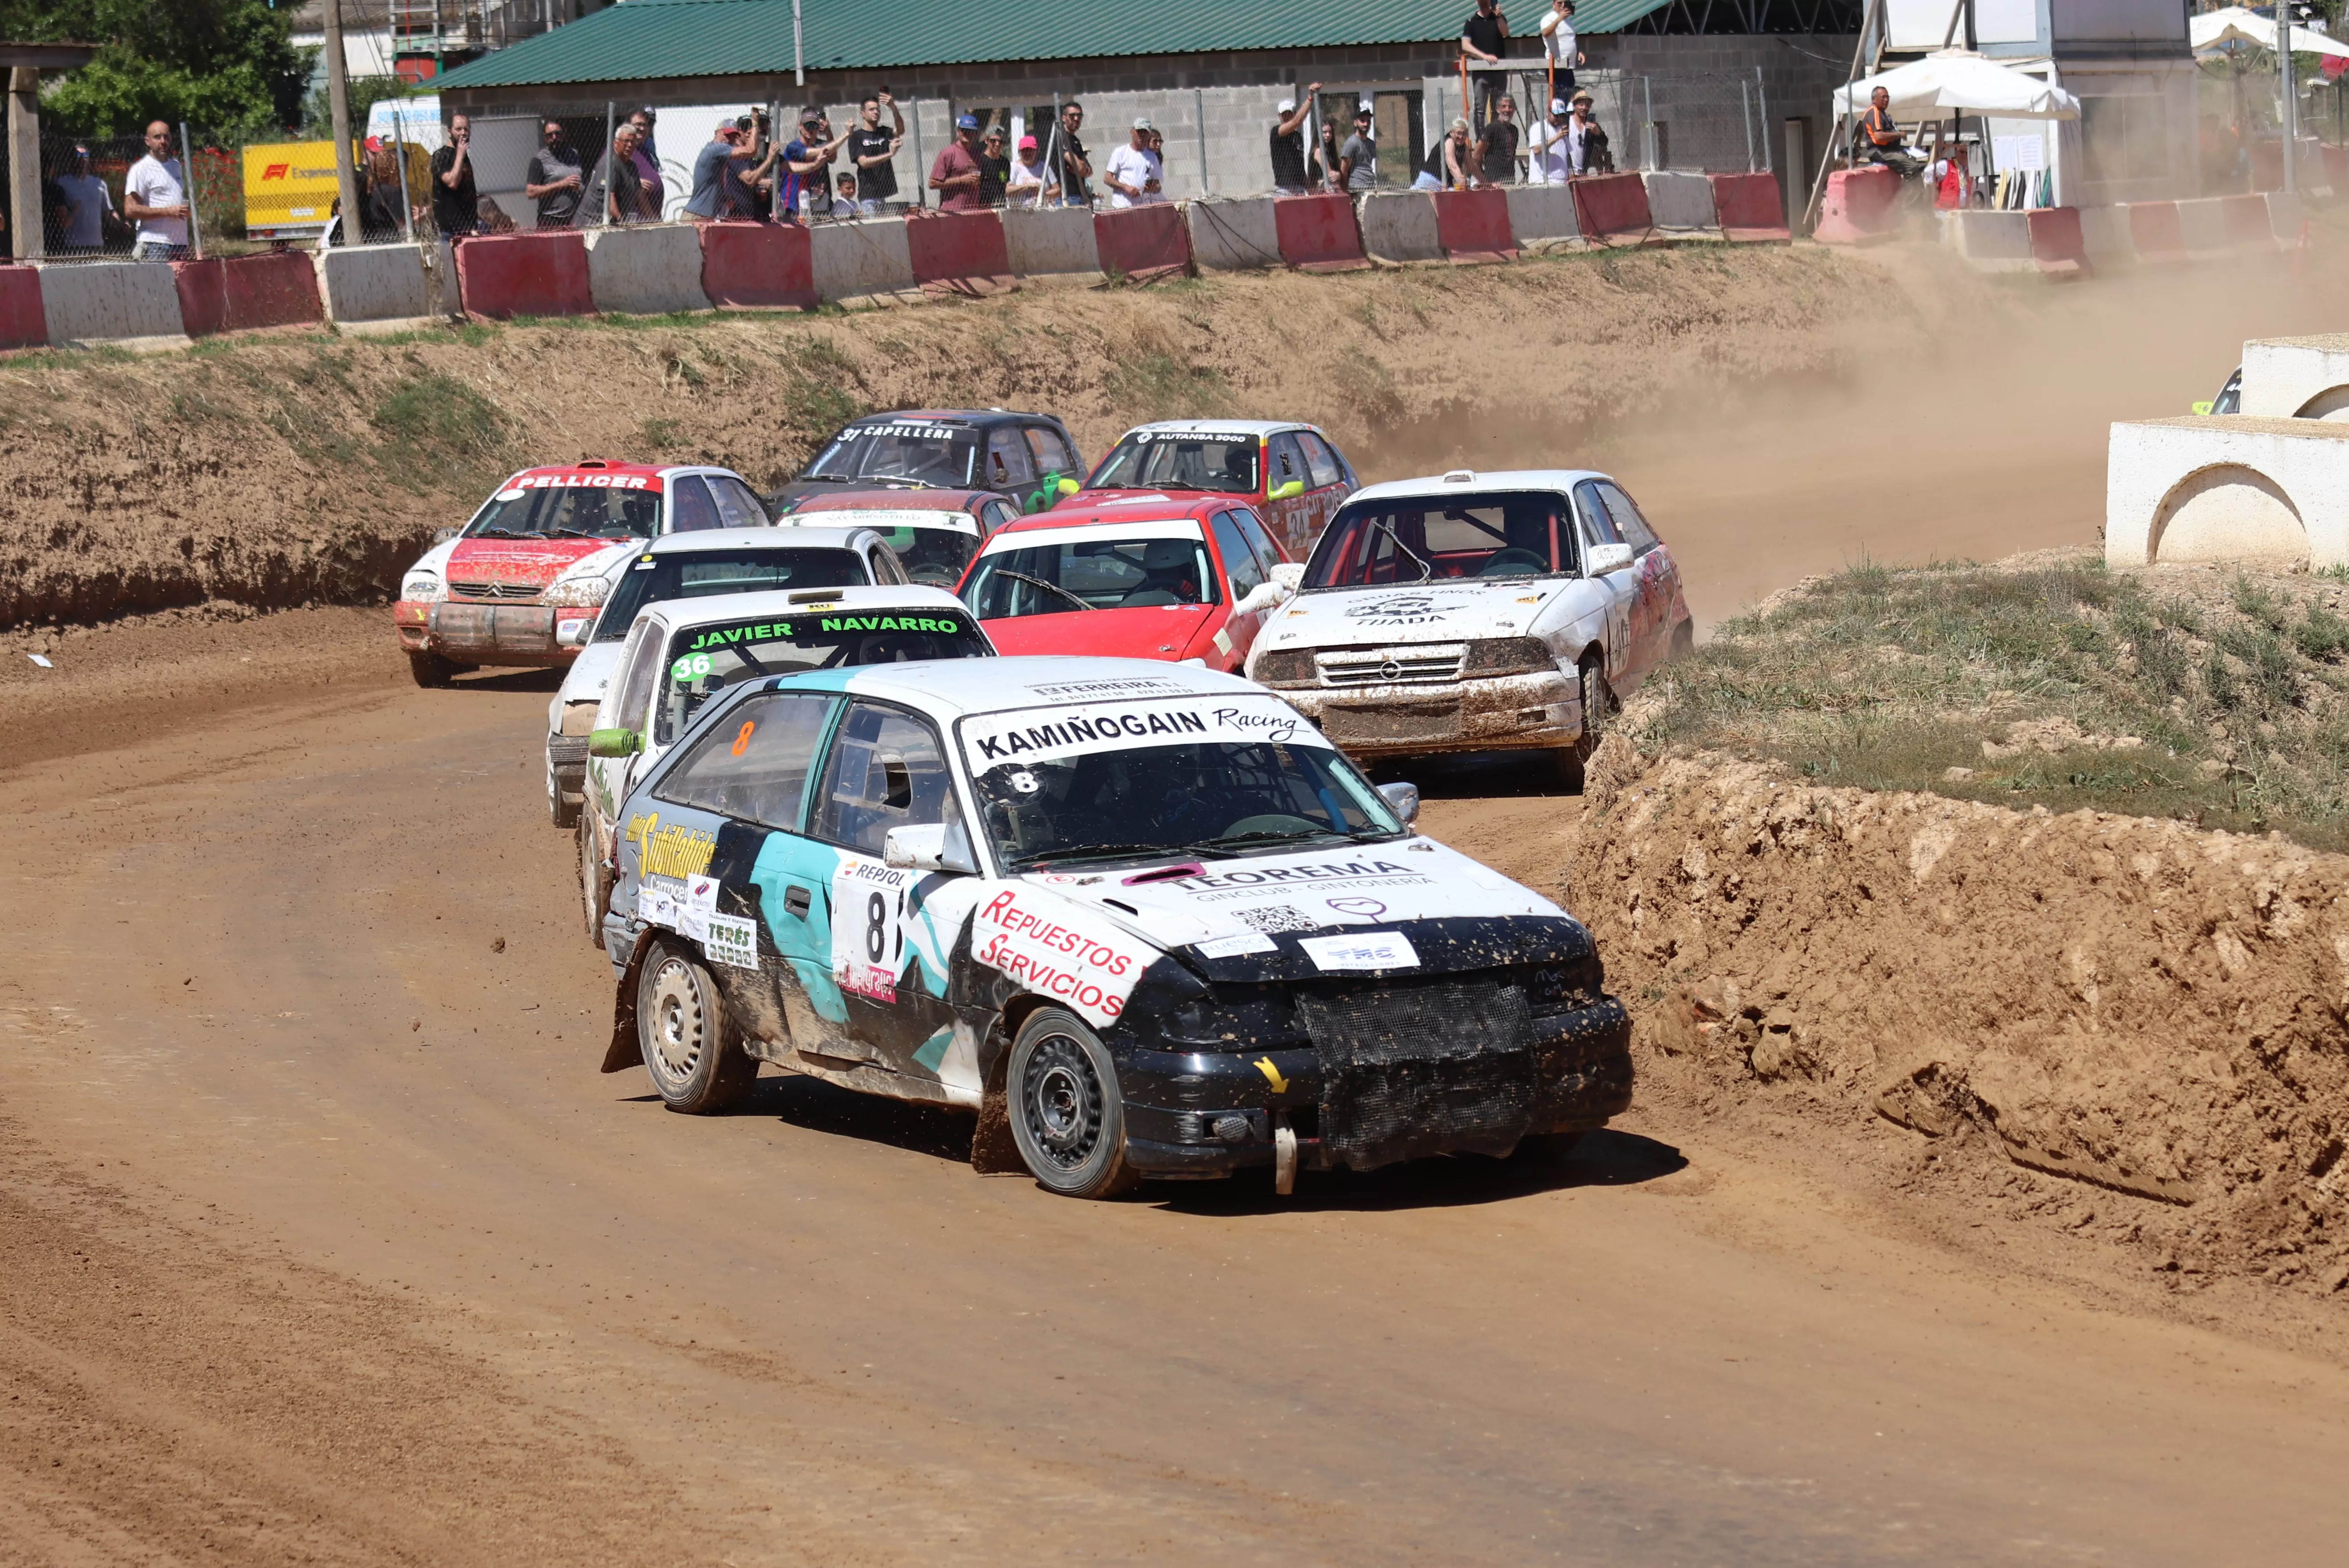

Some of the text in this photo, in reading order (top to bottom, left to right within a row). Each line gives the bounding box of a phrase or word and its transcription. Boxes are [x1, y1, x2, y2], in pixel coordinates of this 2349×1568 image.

[837, 426, 953, 442] 31 CAPELLERA
[1215, 434, 1246, 442] 3000
[517, 475, 647, 489] PELLICER
[1347, 591, 1422, 603] GRUAS
[1356, 615, 1447, 626] TIJADA
[690, 617, 958, 650] JAVIER NAVARRO
[674, 654, 711, 679] 36
[1060, 681, 1162, 693] FERREIRA
[732, 721, 754, 756] 8
[977, 708, 1311, 760] KAMIÑOGAIN Racing
[1012, 772, 1039, 793] 8
[856, 864, 905, 887] REPSOL
[1160, 861, 1416, 891] TEOREMA
[1196, 887, 1292, 903] GINCLUB
[1306, 875, 1439, 891] GINTONERÍA
[708, 923, 750, 947] TERÉS
[866, 891, 886, 963] 8
[1203, 937, 1268, 953] Huesca
